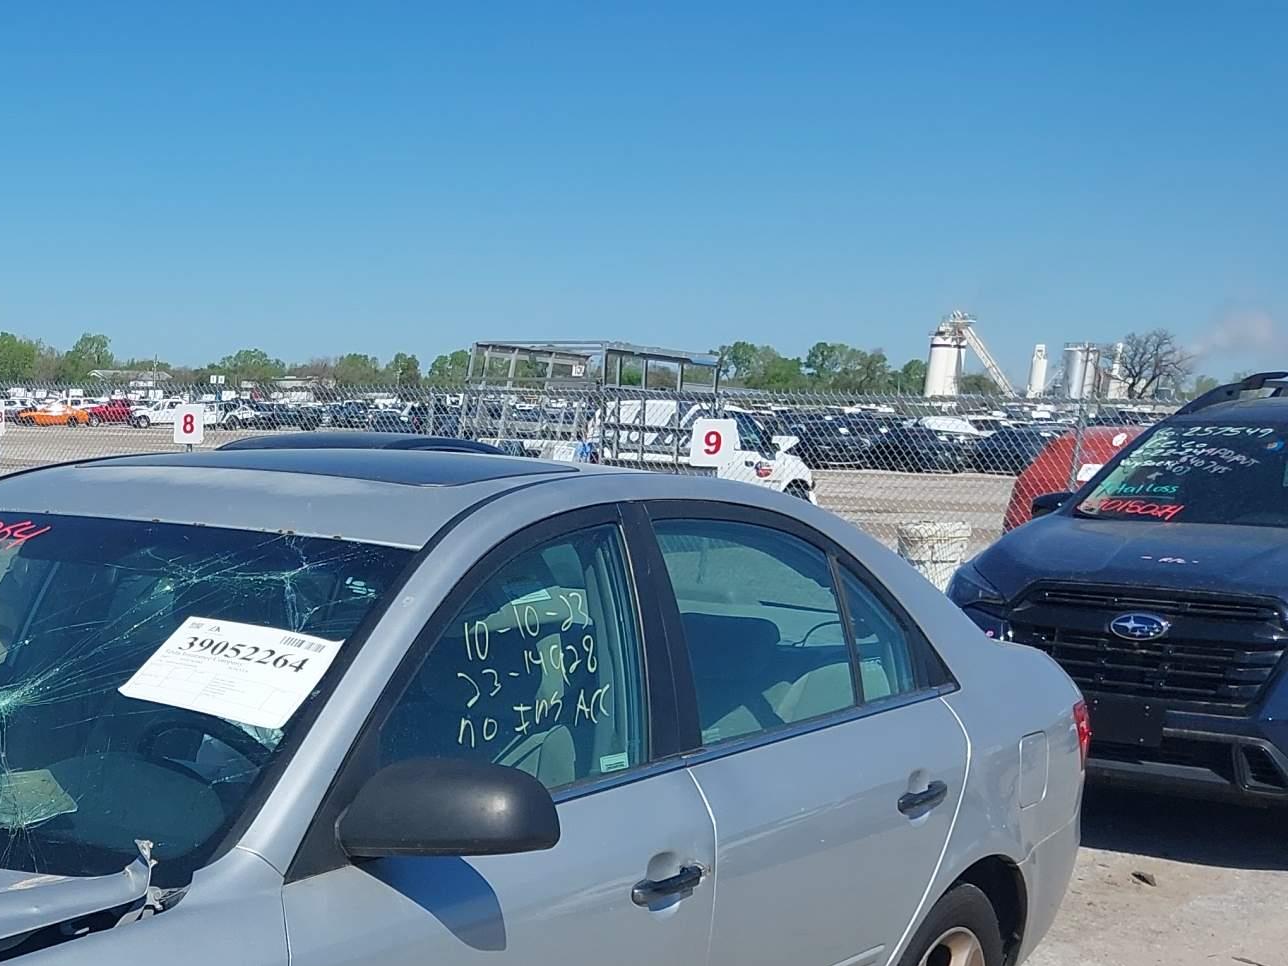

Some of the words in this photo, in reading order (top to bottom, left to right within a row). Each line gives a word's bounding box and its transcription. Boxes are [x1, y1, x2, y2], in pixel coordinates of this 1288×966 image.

[182, 413, 194, 434] 8
[703, 430, 722, 455] 9
[178, 636, 310, 673] 39052264
